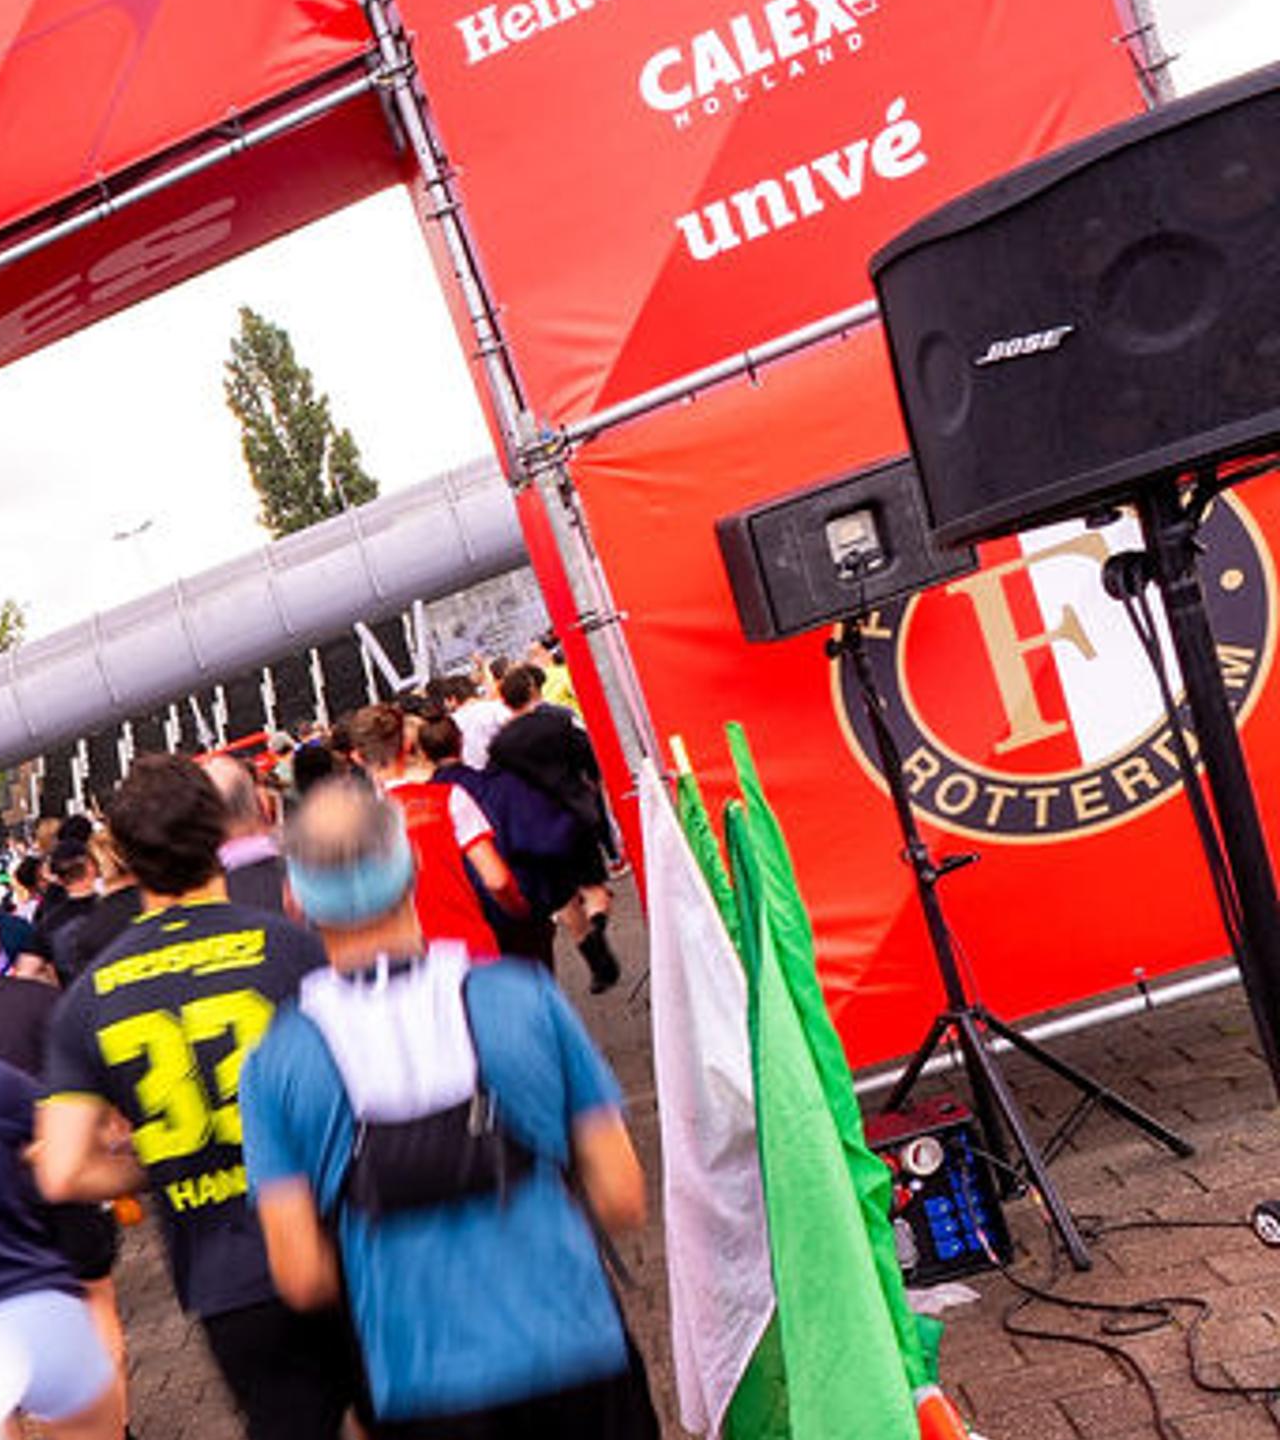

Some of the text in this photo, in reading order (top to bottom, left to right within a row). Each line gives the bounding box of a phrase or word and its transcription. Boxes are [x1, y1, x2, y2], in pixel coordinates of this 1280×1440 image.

[672, 33, 863, 130] HOLLAND
[675, 96, 929, 260] univé
[976, 326, 1072, 365] BOSE
[902, 643, 1256, 828] ROTTERDM
